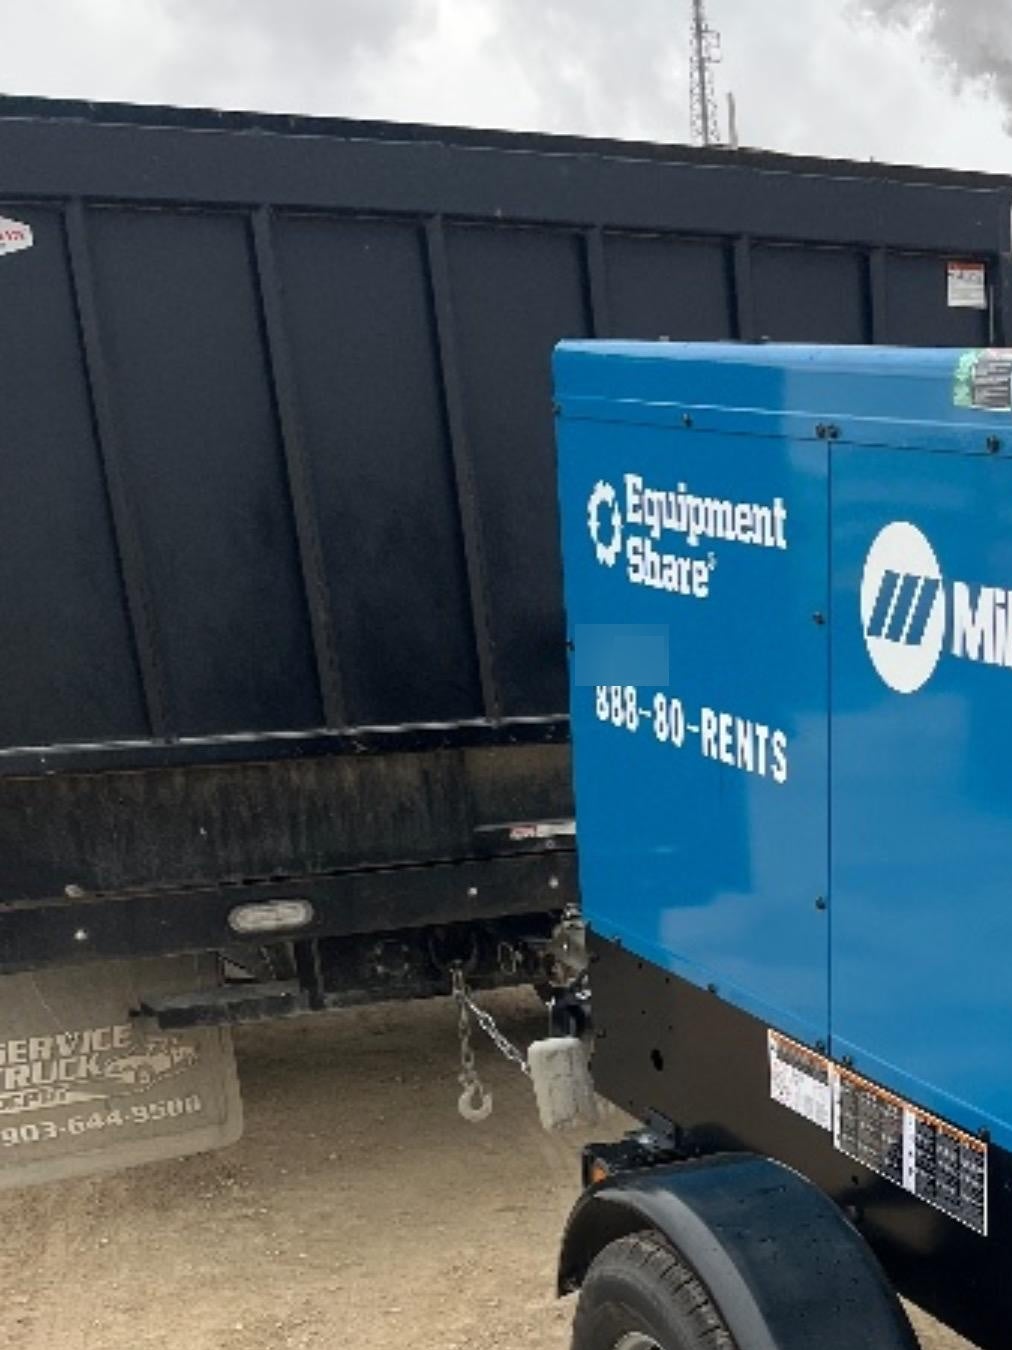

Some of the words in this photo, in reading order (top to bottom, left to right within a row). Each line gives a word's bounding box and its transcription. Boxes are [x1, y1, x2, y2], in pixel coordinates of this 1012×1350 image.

[624, 473, 788, 550] Equipment
[626, 536, 710, 598] Share
[596, 685, 788, 784] 888-80-RENTS
